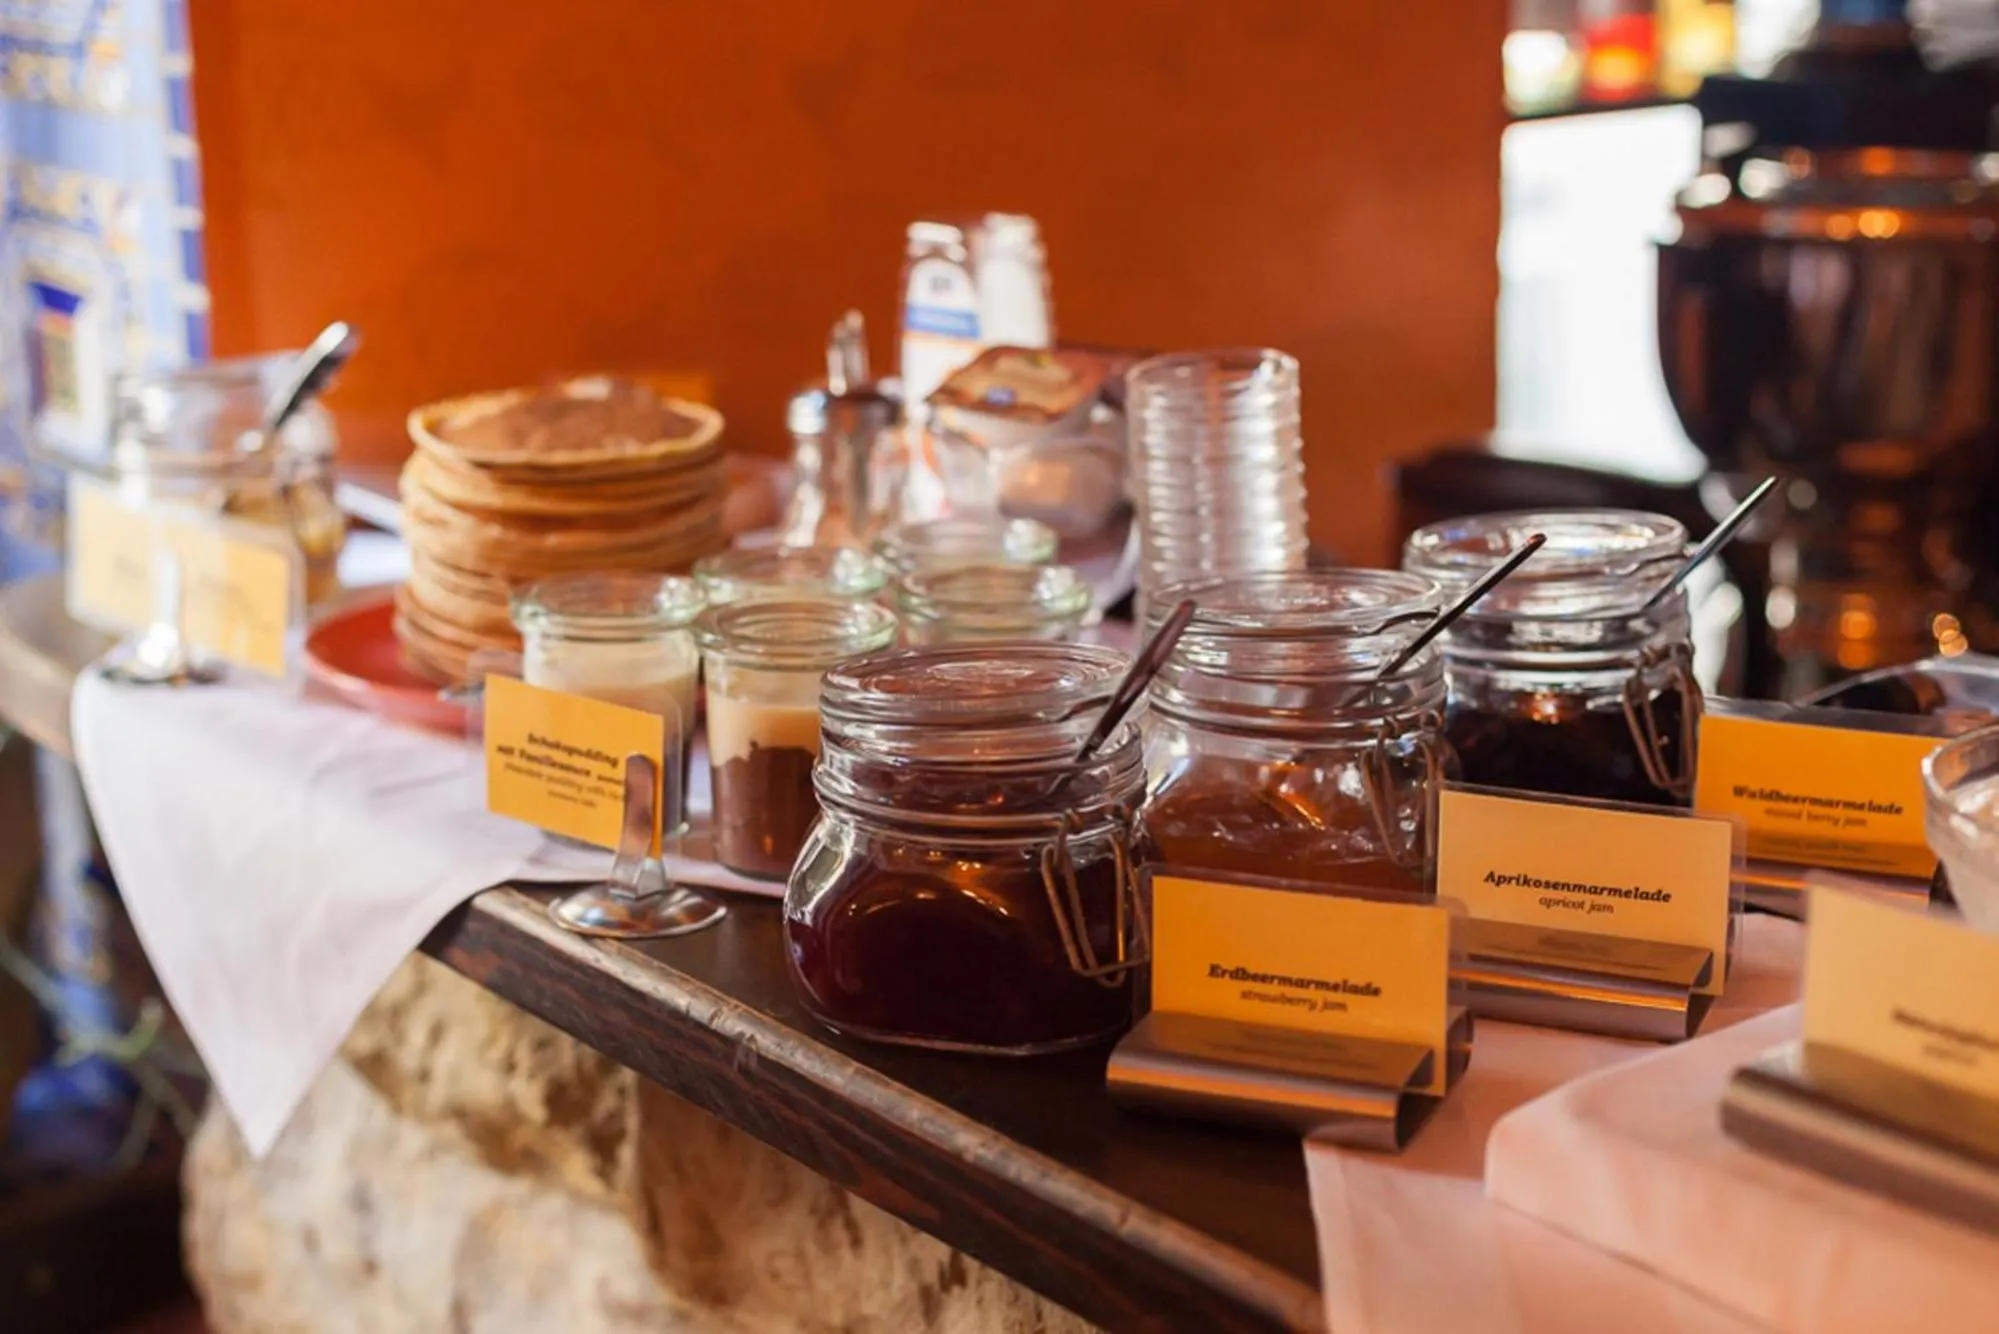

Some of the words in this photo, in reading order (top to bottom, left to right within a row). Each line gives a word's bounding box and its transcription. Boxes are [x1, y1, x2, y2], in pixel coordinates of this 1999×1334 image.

[527, 732, 618, 768] Schokopudding
[1733, 785, 1904, 815] Waldbeermarmelade
[1806, 809, 1841, 827] berry
[1842, 816, 1868, 829] jam
[1483, 870, 1672, 903] Aprikosenmarmelade
[1538, 895, 1585, 910] apricot
[1587, 902, 1614, 915] jam
[1208, 963, 1382, 998] Erdbeermarmelade
[1240, 989, 1318, 1012] strawberry
[1318, 997, 1348, 1013] jam
